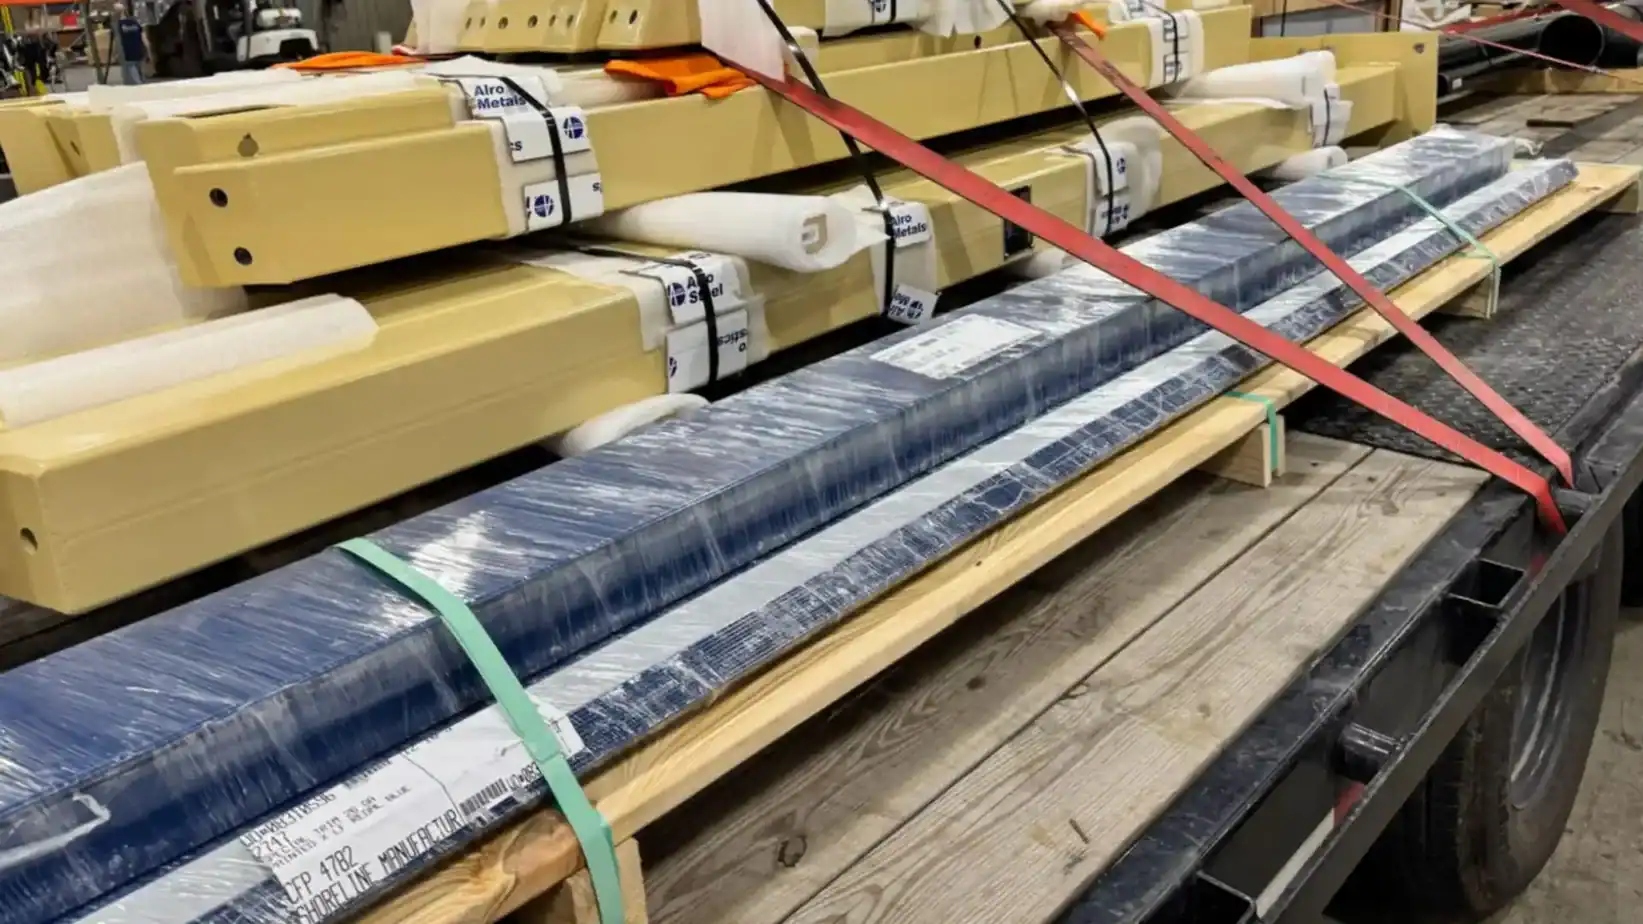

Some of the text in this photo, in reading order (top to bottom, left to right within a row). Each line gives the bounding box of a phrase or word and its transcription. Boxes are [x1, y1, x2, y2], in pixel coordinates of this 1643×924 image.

[474, 84, 505, 97] Alro
[477, 95, 527, 110] Metals
[320, 845, 361, 882] 4782
